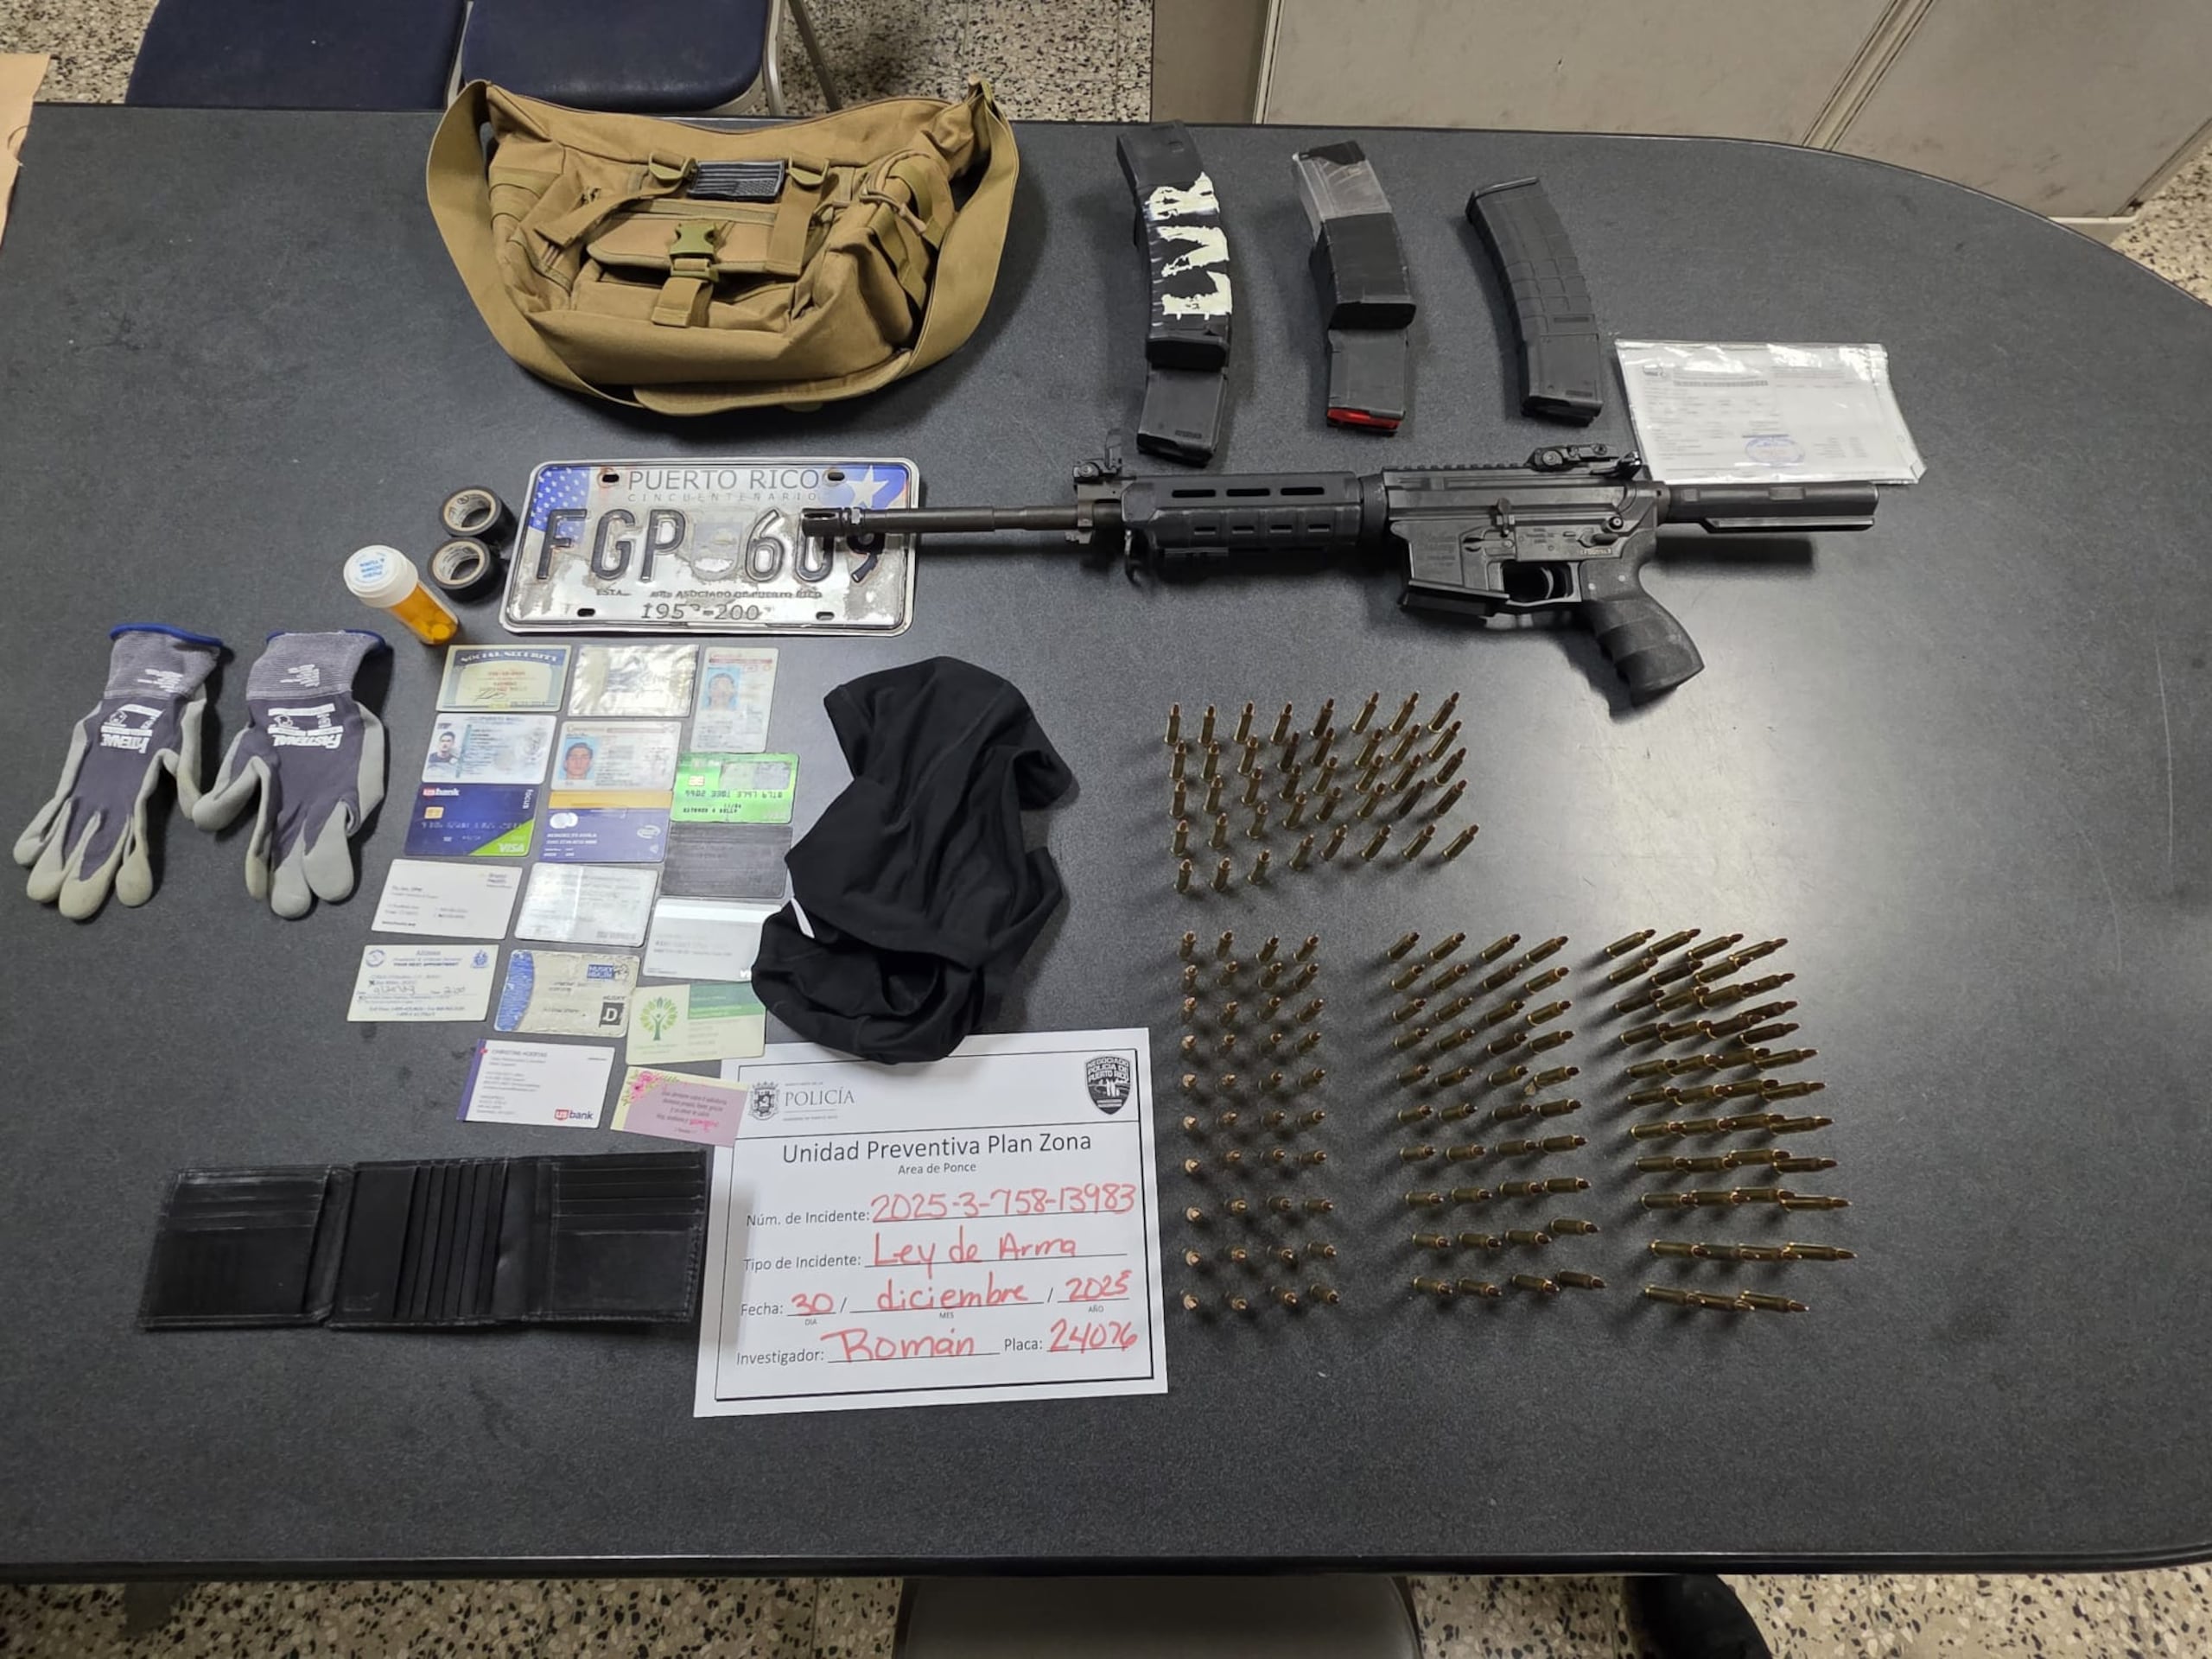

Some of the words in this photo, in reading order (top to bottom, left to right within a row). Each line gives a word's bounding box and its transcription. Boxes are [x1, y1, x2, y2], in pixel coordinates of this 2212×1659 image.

[628, 469, 737, 490] PUERTO
[749, 468, 819, 490] RICO
[627, 493, 817, 502] CINCUENTENARIO
[537, 508, 686, 582] FGP
[499, 843, 525, 853] VISA
[603, 1007, 619, 1022] D
[785, 1087, 855, 1106] POLICÍA
[783, 1141, 859, 1163] Unidad
[868, 1137, 980, 1160] Preventiva
[988, 1134, 1032, 1154] Plan
[1039, 1133, 1091, 1152] Zona
[898, 1166, 924, 1175] Area
[926, 1164, 940, 1173] de
[944, 1162, 977, 1173] Ponce
[747, 1213, 781, 1226] Núm.
[785, 1212, 801, 1224] de
[805, 1211, 870, 1224] Incidente:
[744, 1258, 772, 1273] Tipo
[775, 1257, 791, 1269] de
[796, 1255, 861, 1268] Incidente:
[874, 1232, 936, 1280] Ley
[949, 1225, 982, 1264] de
[999, 1232, 1077, 1260] Arma
[740, 1302, 784, 1317] Fecha:
[791, 1294, 834, 1317] 30
[877, 1270, 1028, 1310] diciembre
[1088, 1304, 1104, 1313] AÑO
[736, 1349, 824, 1366] Investigador:
[1004, 1337, 1043, 1351] Placa:
